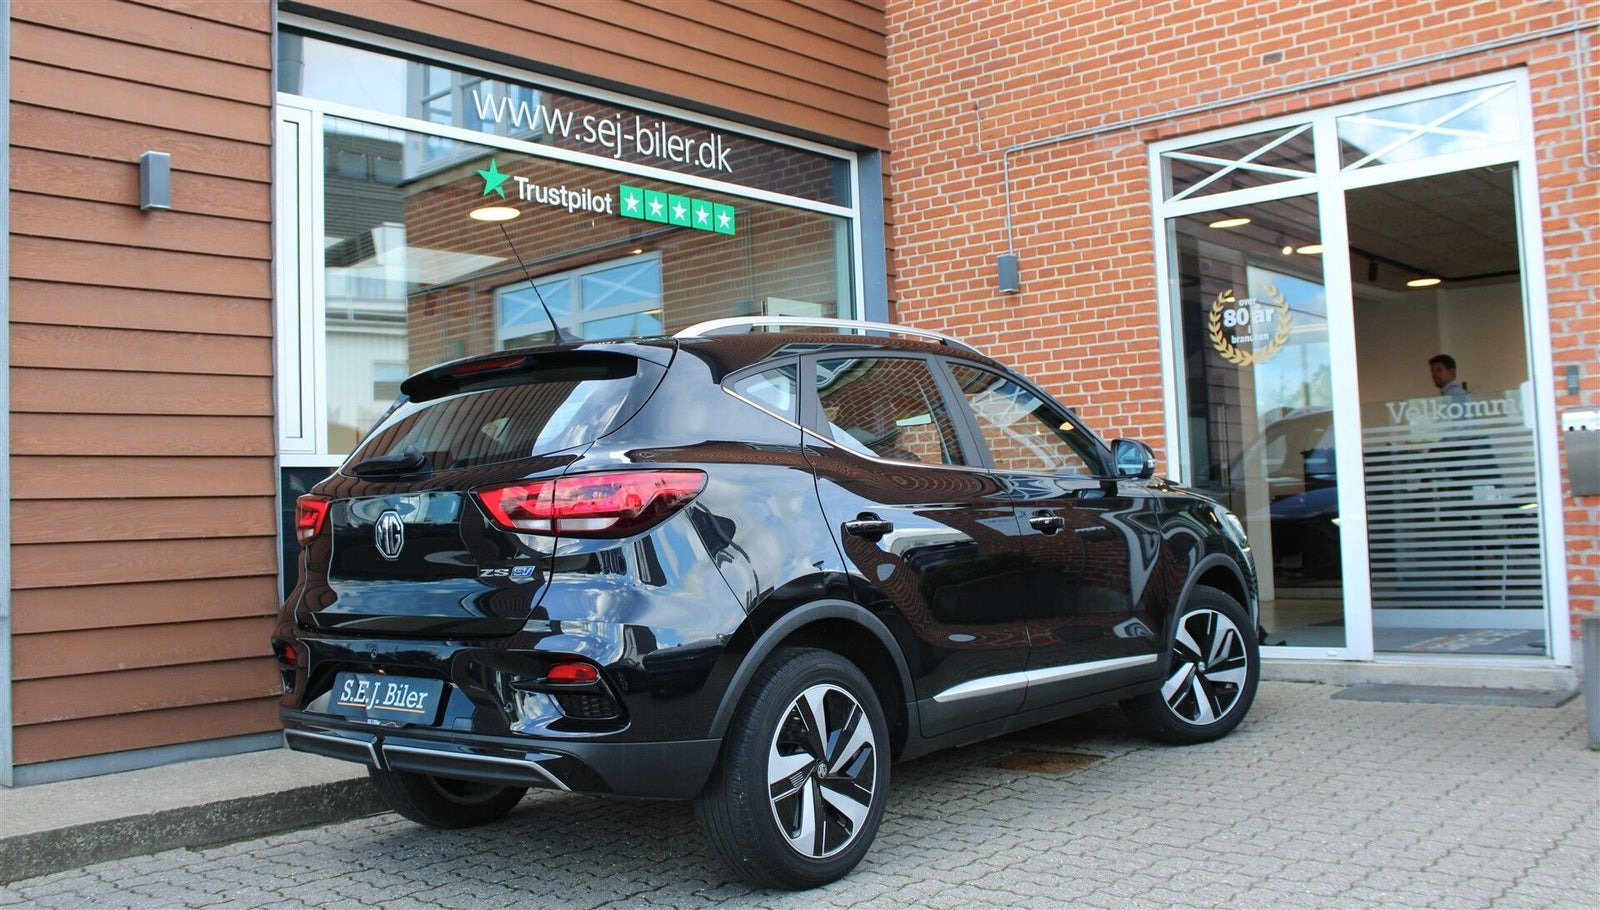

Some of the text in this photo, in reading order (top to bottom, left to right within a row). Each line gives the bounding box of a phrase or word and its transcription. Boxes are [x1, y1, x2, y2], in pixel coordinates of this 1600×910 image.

[472, 89, 733, 173] www.sej-biler.dk
[513, 175, 613, 214] Trustpilot
[1223, 303, 1274, 327] 80 år
[1238, 298, 1257, 306] over
[1231, 332, 1270, 344] branchen
[377, 514, 401, 556] MG
[480, 568, 509, 577] ZS
[340, 679, 428, 710] S.E.J. Biler
